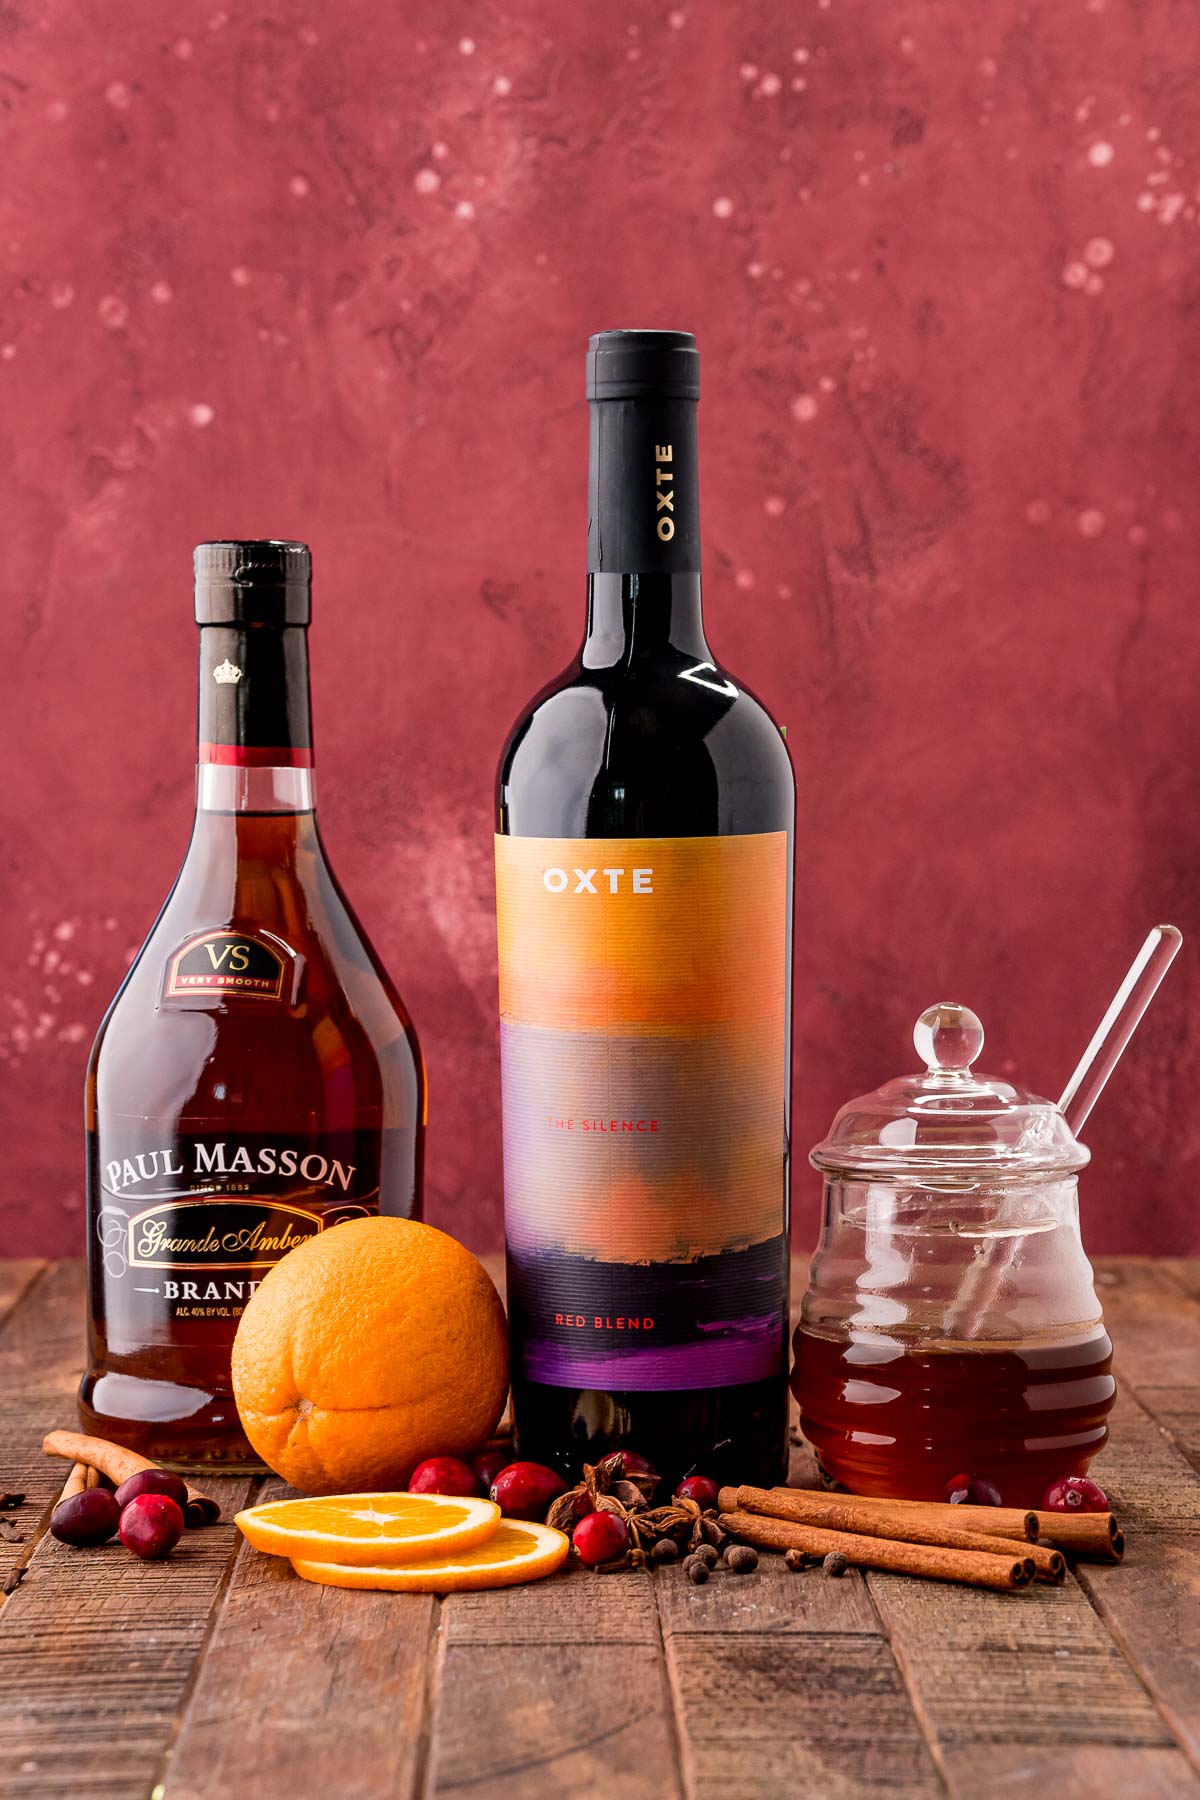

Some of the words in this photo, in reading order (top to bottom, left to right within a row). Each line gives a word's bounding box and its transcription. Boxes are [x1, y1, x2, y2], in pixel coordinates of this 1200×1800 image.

[655, 444, 675, 542] OXTE
[543, 867, 653, 894] OXTE
[204, 943, 250, 970] VS
[181, 976, 213, 985] VERY
[217, 976, 269, 987] SMOOTH
[548, 1116, 574, 1130] THE
[582, 1119, 659, 1132] SILENCE
[106, 1149, 184, 1193] PAUL
[193, 1142, 357, 1191] MASSON
[137, 1219, 221, 1257] Grande
[191, 1306, 205, 1317] 40%
[206, 1306, 216, 1317] BY
[555, 1313, 586, 1327] RED
[594, 1316, 654, 1330] BLEND
